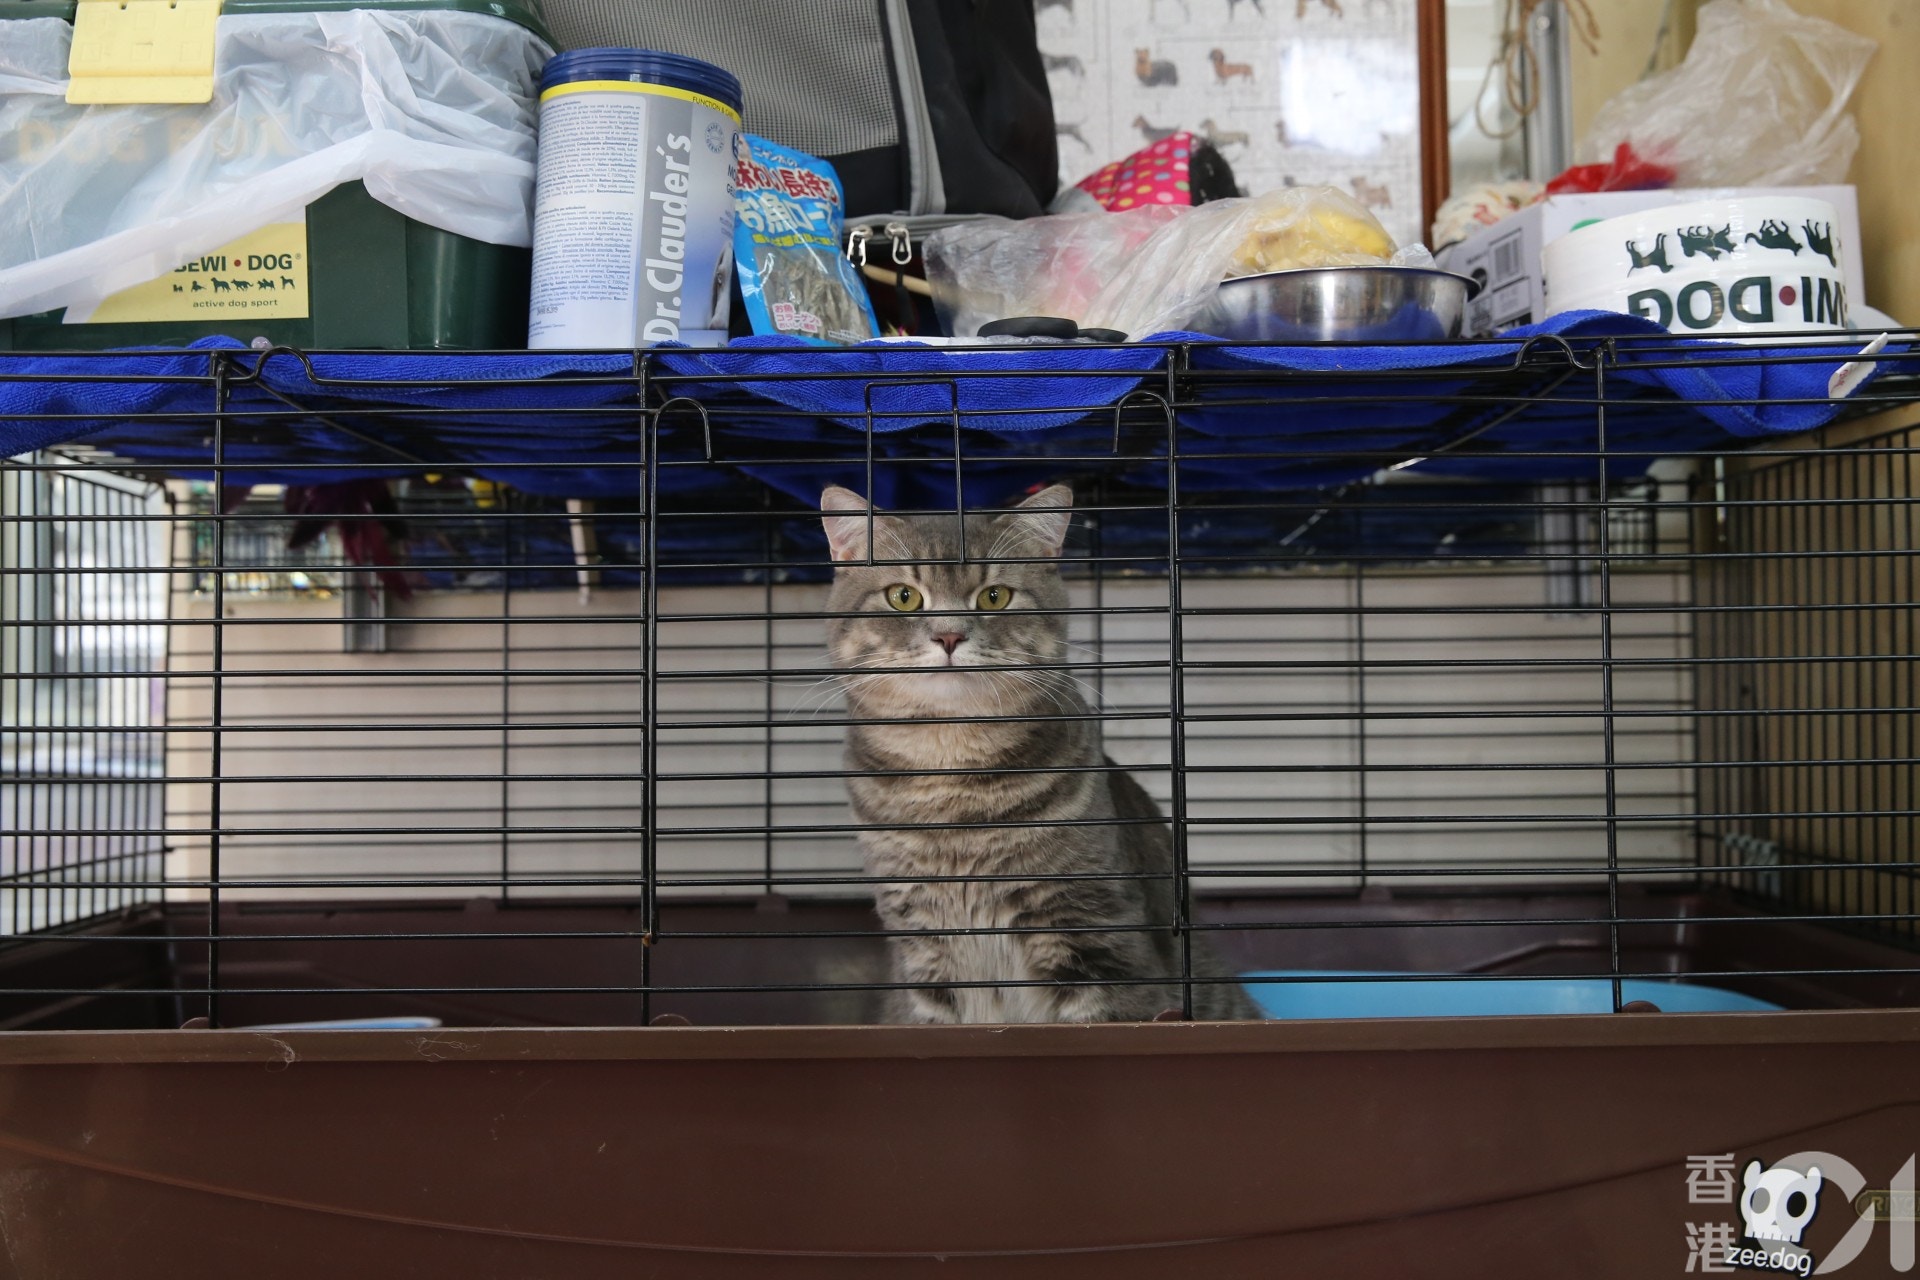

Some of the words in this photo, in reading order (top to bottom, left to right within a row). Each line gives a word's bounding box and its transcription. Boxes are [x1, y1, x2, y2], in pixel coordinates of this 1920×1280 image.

[248, 253, 293, 270] DOG
[228, 299, 247, 308] dog
[251, 299, 278, 308] sport
[1626, 275, 1775, 333] DOG
[1801, 276, 1847, 329] WI
[1725, 1247, 1812, 1277] zee.dog
